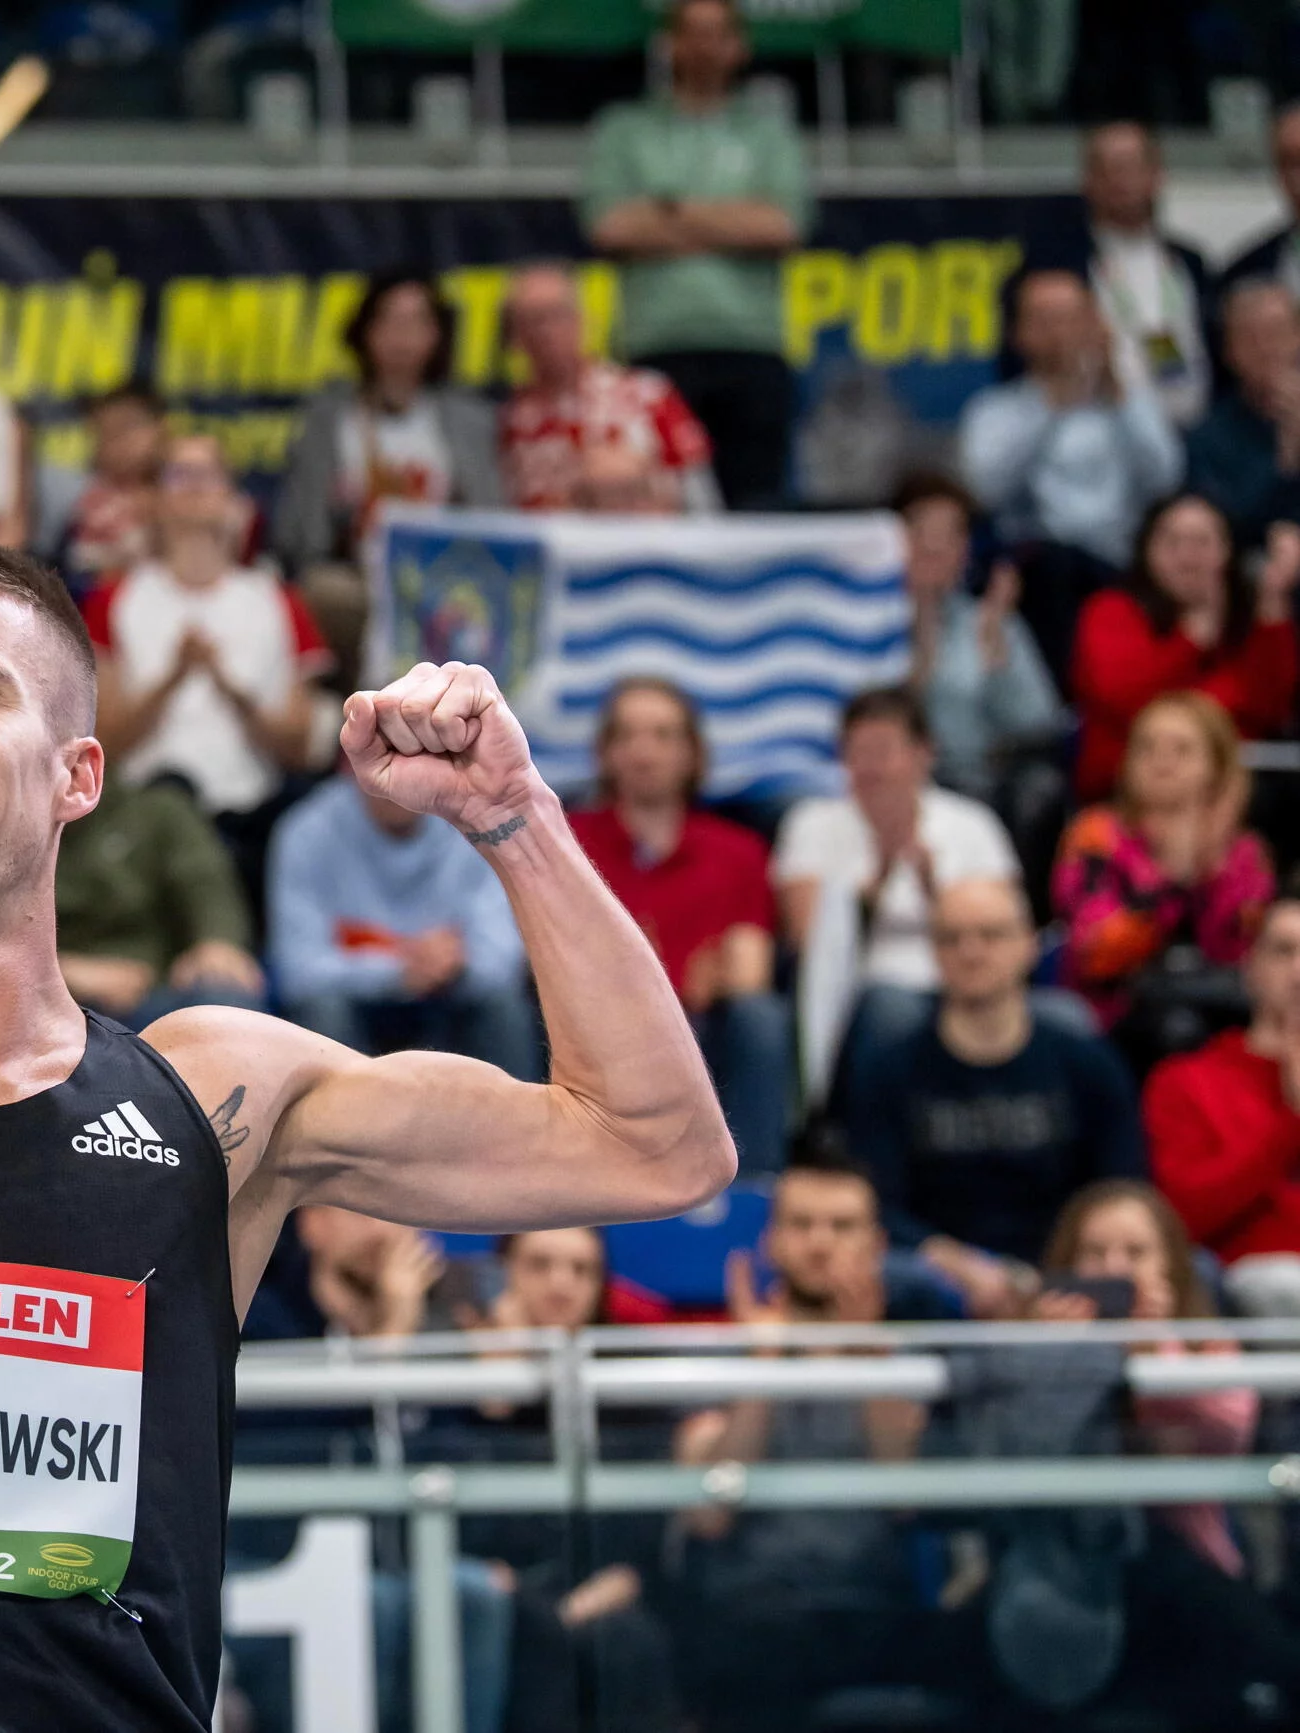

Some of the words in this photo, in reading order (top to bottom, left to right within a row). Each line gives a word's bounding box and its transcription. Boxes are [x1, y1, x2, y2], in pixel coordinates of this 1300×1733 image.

[158, 270, 618, 392] MIAT
[71, 1134, 181, 1167] adidas
[27, 1567, 70, 1581] INDOOR
[72, 1573, 99, 1587] TOUR
[48, 1579, 77, 1592] GOLD
